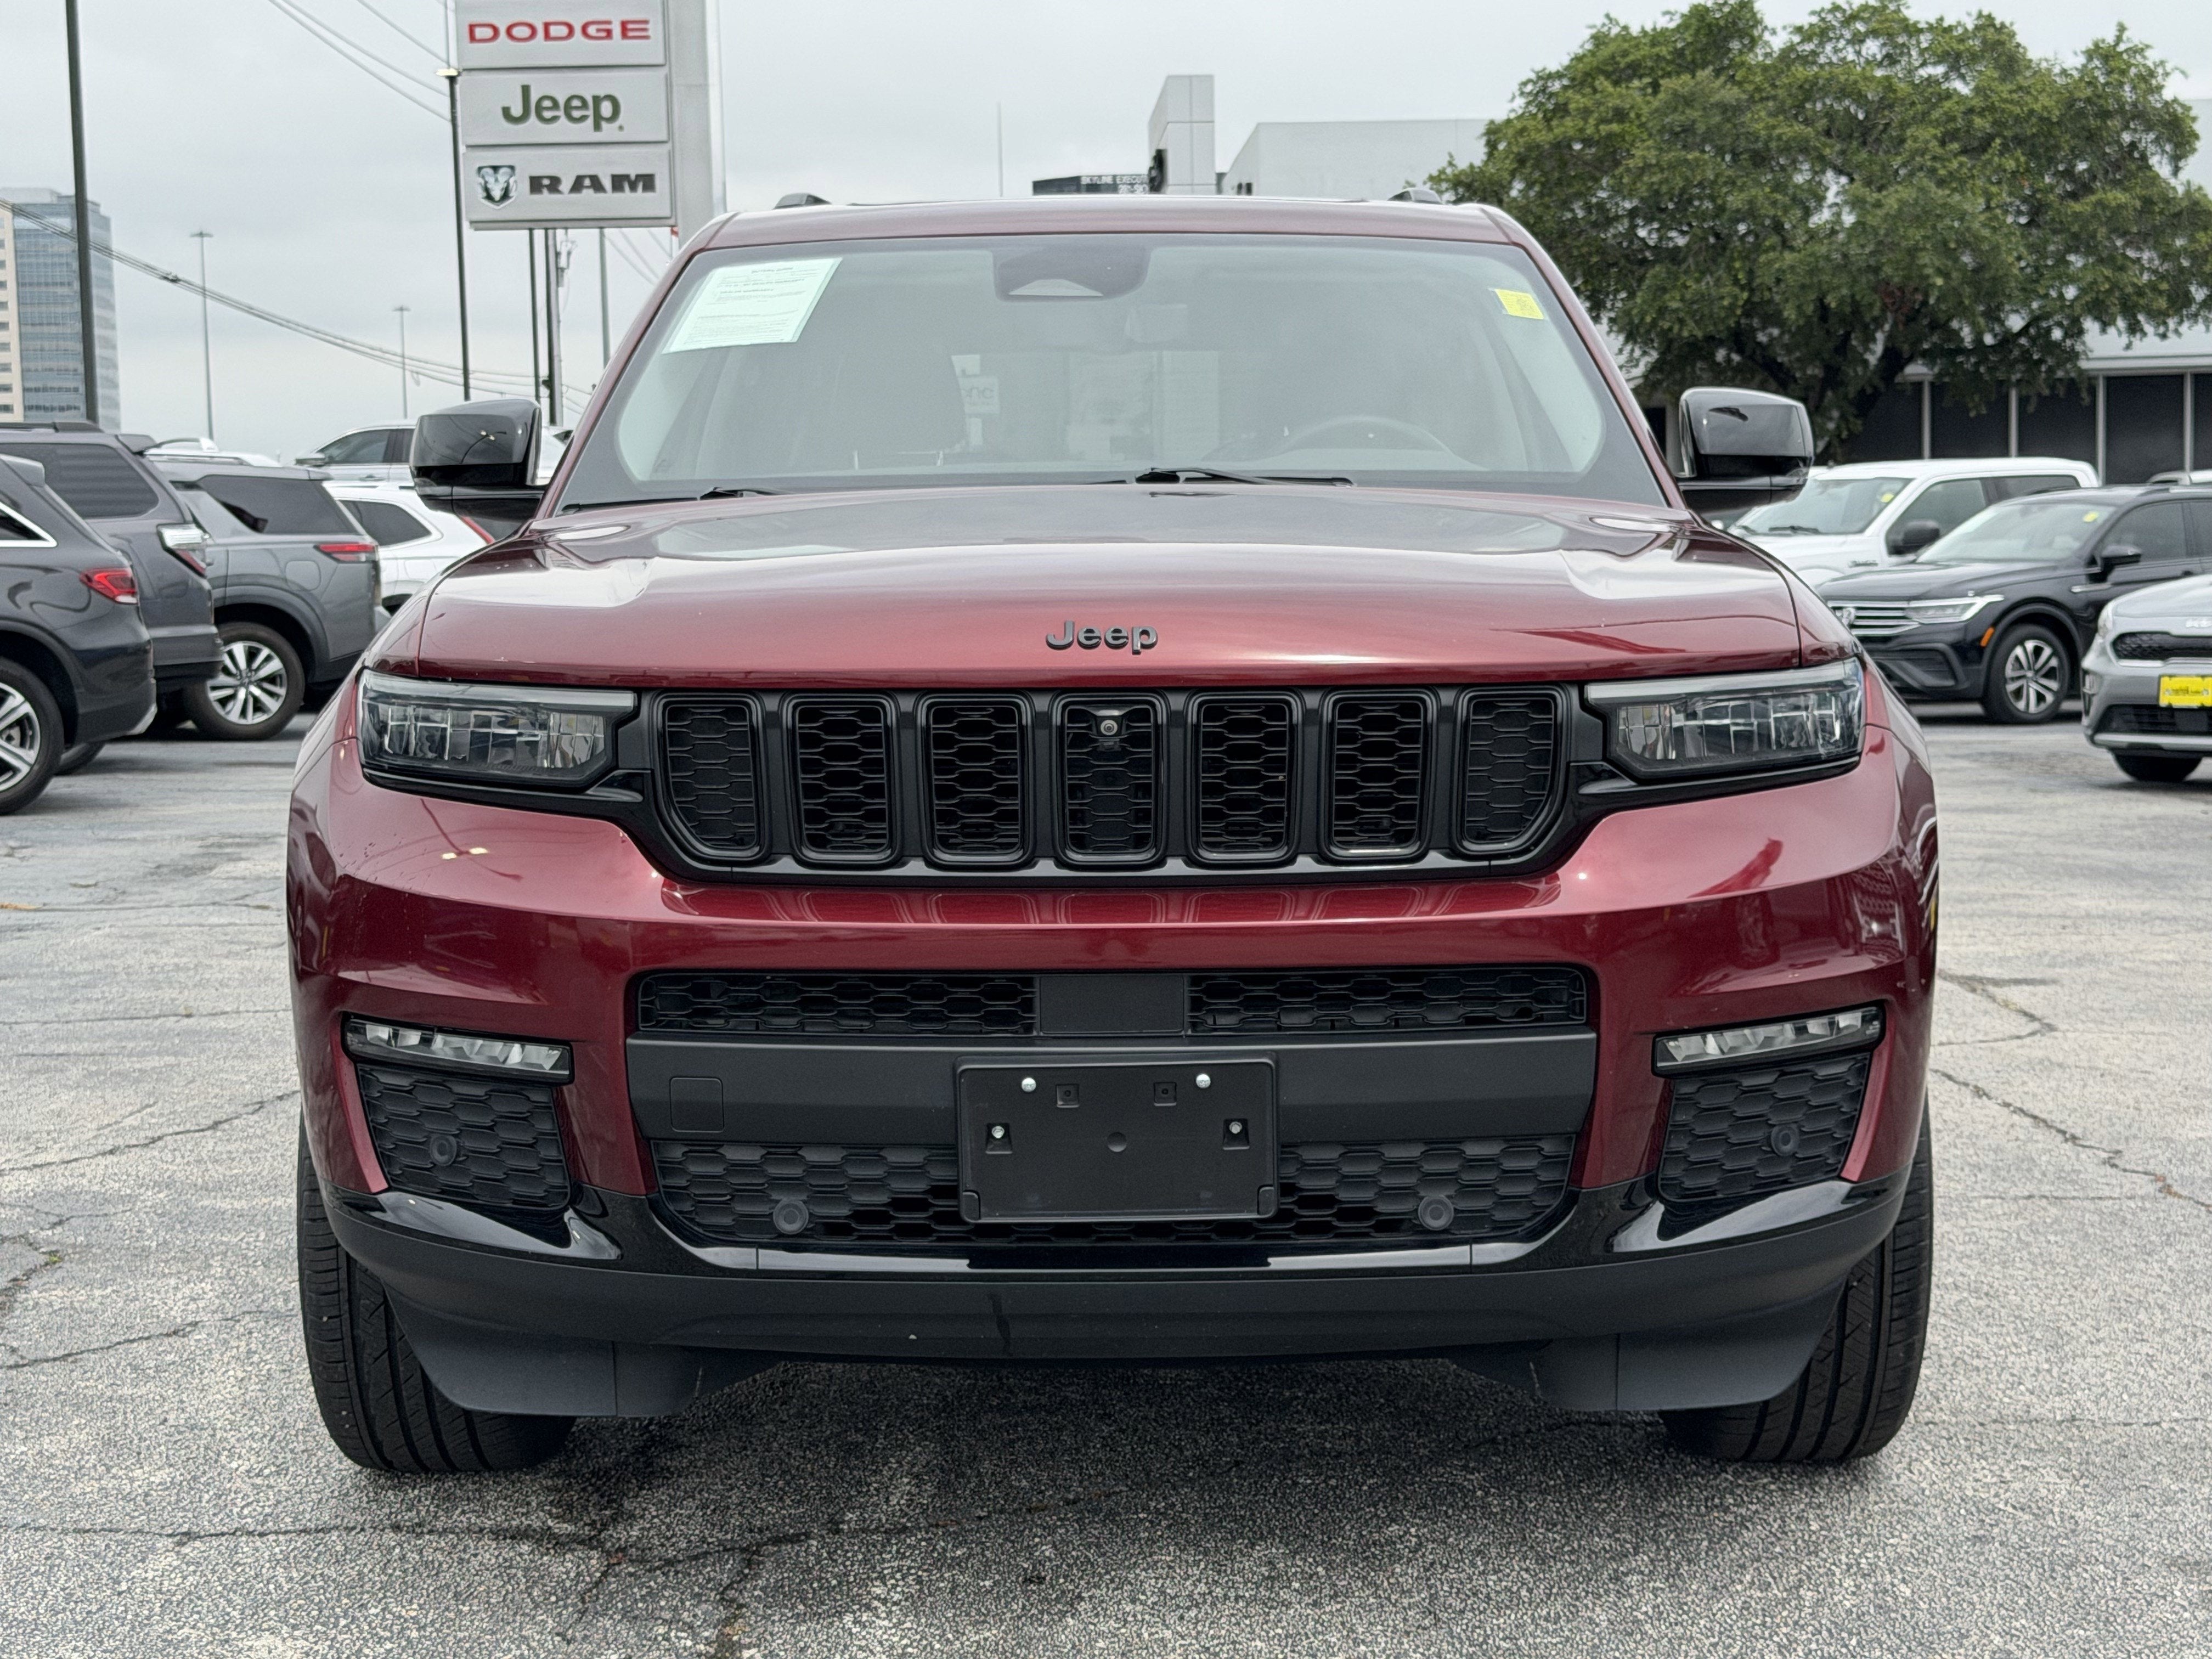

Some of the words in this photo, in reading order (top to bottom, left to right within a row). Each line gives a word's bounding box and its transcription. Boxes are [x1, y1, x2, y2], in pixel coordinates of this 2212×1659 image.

[468, 19, 651, 43] DODGE
[529, 173, 657, 195] RAM
[1046, 620, 1158, 655] Jeep
